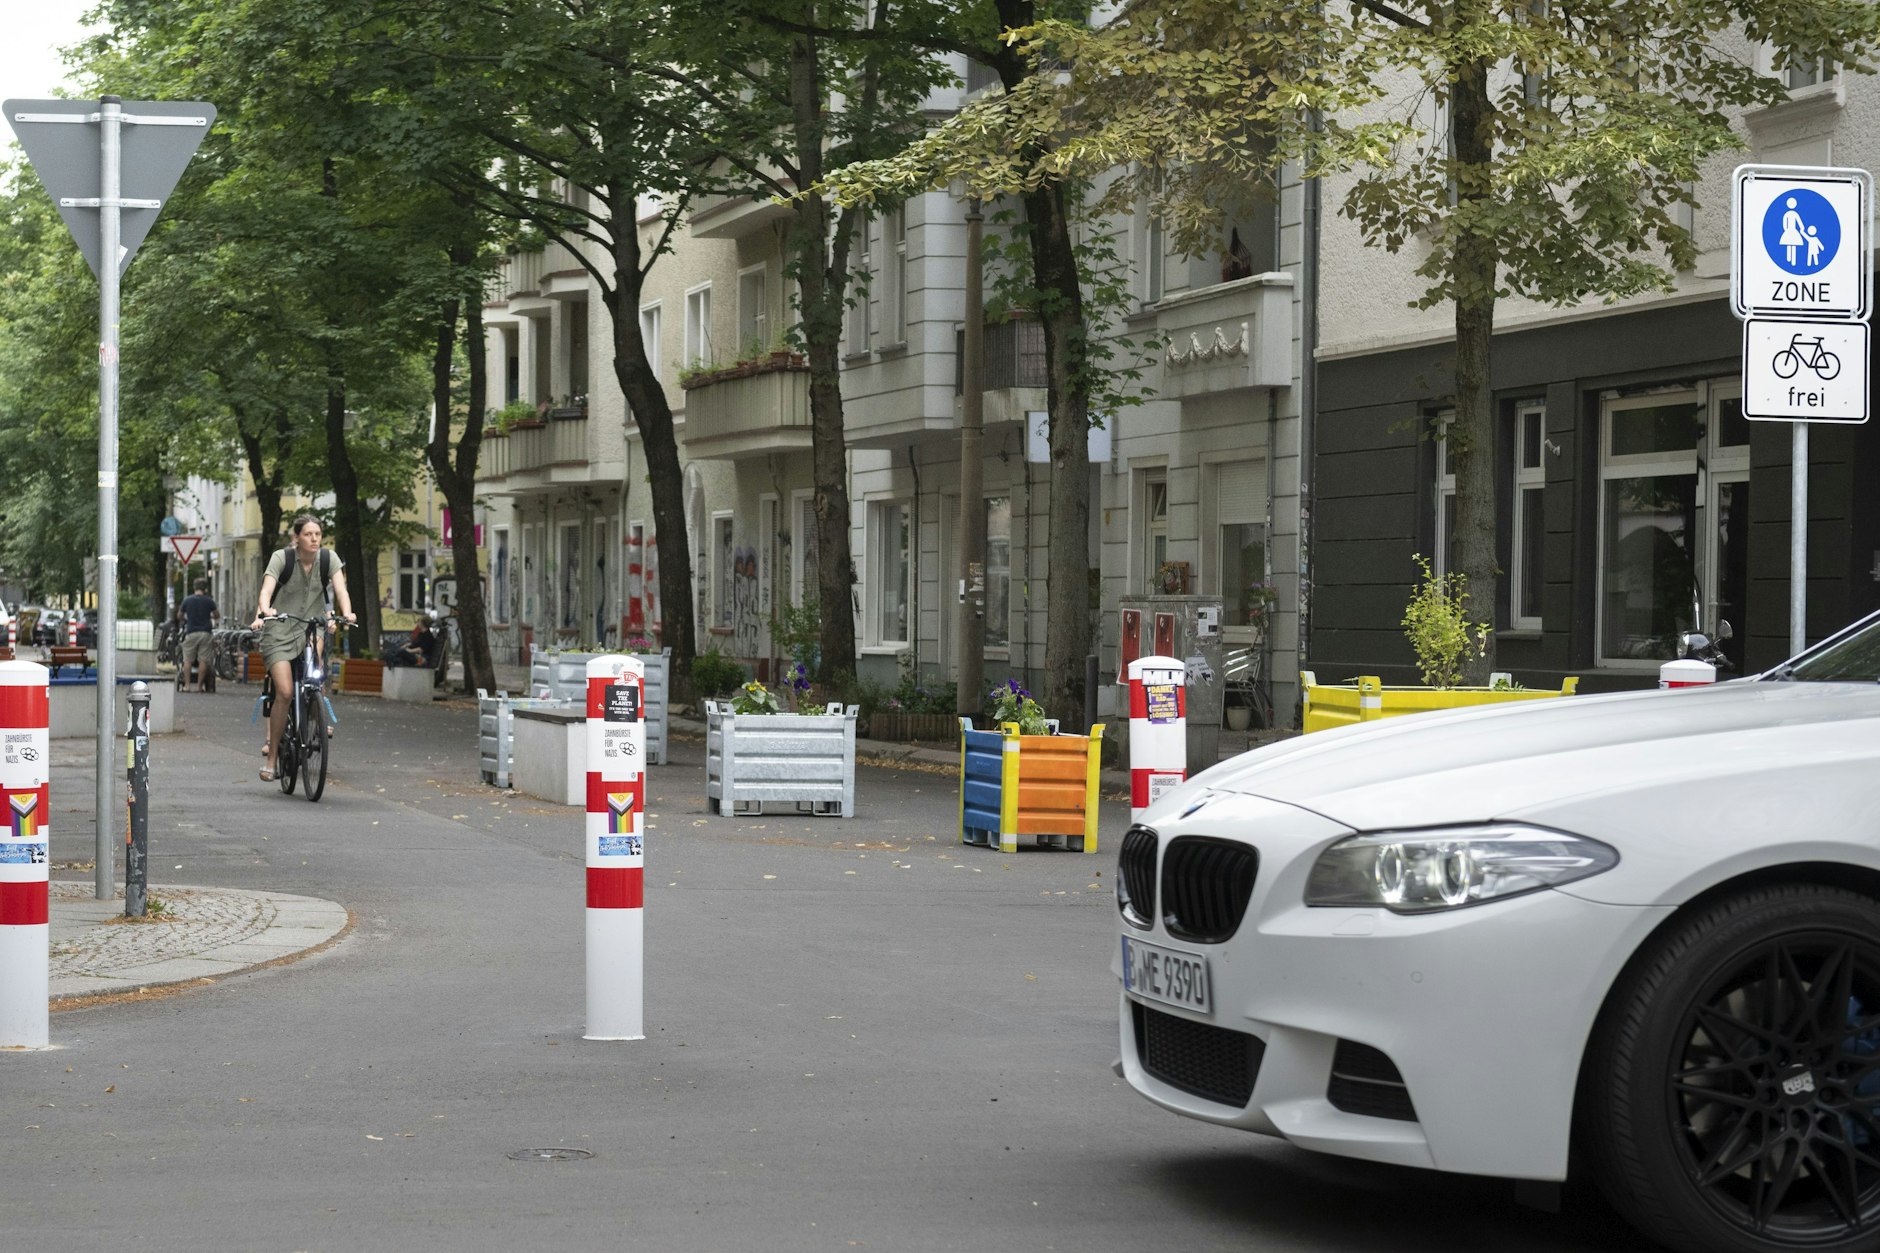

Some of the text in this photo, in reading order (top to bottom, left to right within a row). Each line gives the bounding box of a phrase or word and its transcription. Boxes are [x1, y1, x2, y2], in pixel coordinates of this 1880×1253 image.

[1772, 281, 1830, 302] ZONE
[1788, 387, 1825, 407] frei
[5, 733, 33, 743] ZAHNBÜRSTE
[604, 728, 631, 738] ZAHNBÜRSTE
[604, 739, 613, 747] FÜR
[5, 744, 14, 753] FÜR
[1164, 955, 1204, 1005] 9390
